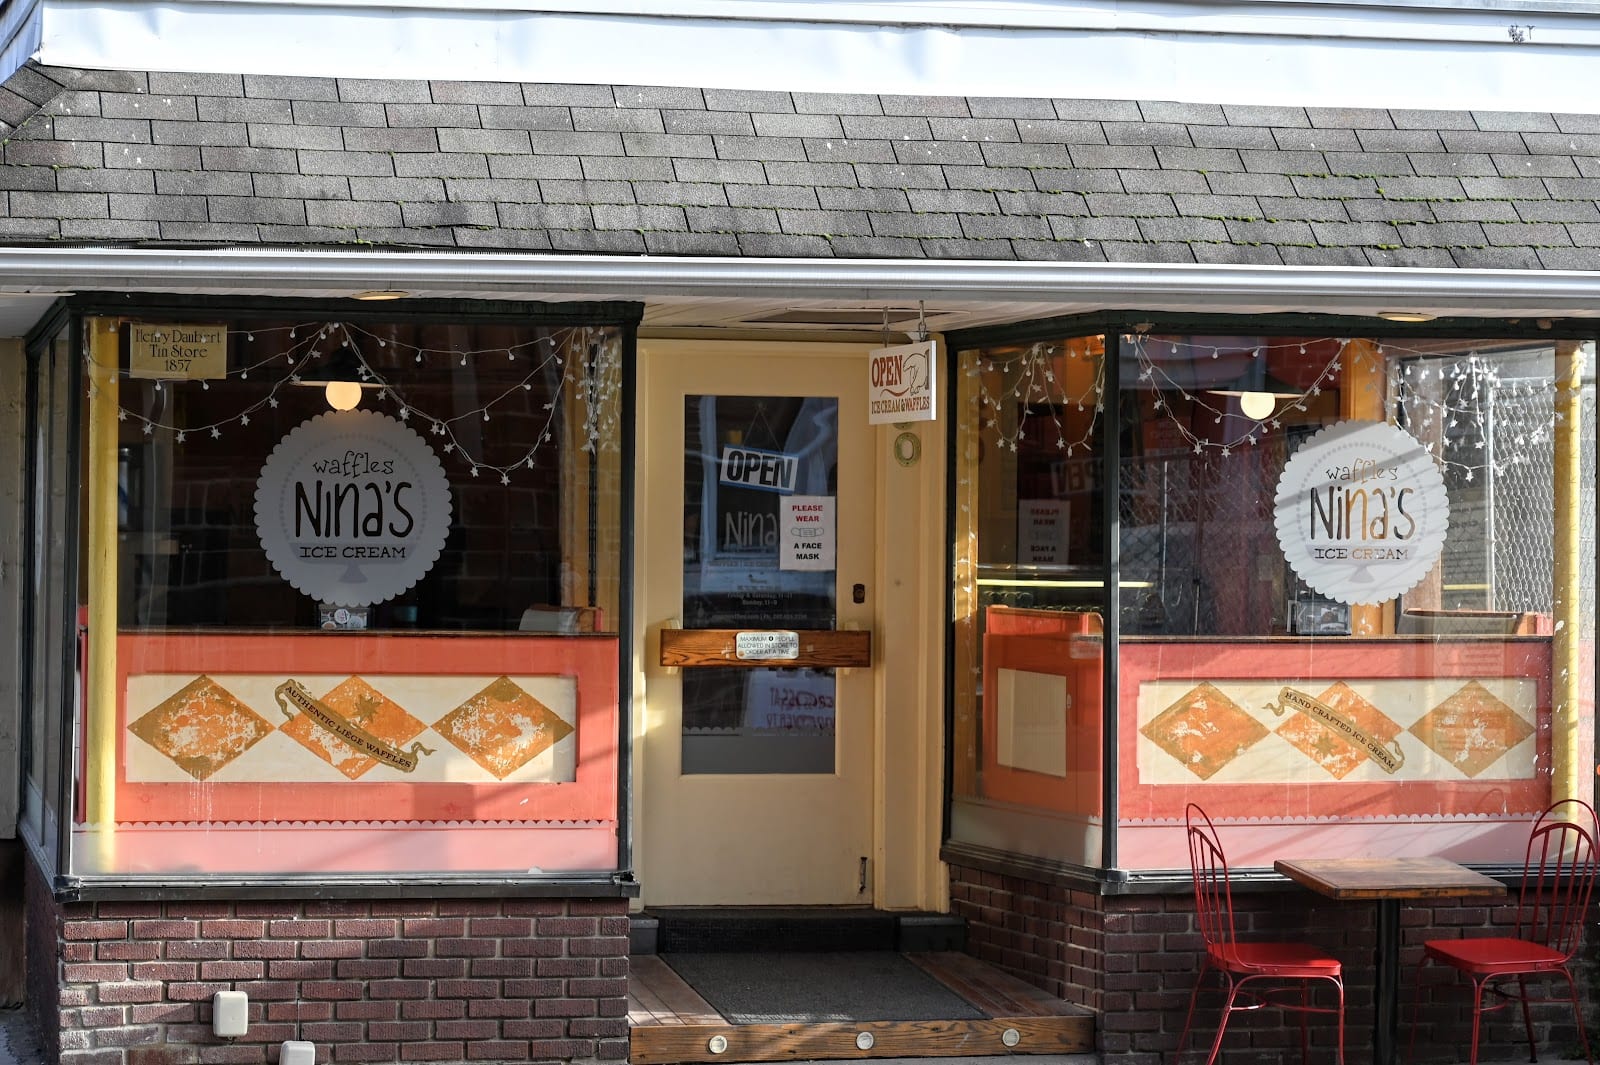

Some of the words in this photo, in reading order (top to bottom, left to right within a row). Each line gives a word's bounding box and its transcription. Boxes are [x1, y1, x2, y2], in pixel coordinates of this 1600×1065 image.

[135, 328, 170, 345] Henry
[149, 343, 168, 358] Tin
[170, 344, 208, 358] Store
[165, 359, 192, 372] 1857
[872, 354, 903, 388] OPEN
[871, 400, 880, 415] ICE
[881, 399, 901, 414] CREAM
[905, 396, 930, 412] WAFFLES
[312, 450, 394, 479] waffles
[726, 450, 793, 489] OPEN
[1326, 458, 1398, 485] waffles
[295, 480, 414, 538] Nina's
[792, 504, 824, 512] PLEASE
[796, 515, 820, 523] WEAR
[1310, 486, 1416, 541] Nina's
[300, 546, 338, 558] ICE
[342, 546, 407, 558] CREAM
[1314, 548, 1348, 560] ICE
[1352, 548, 1409, 560] CREAM
[285, 686, 336, 728] AUTHENTIC
[366, 741, 412, 768] WAFFLES
[1284, 692, 1311, 709] HAND
[1312, 706, 1353, 734] CRAFTED
[1352, 731, 1367, 745] ICE
[1368, 742, 1395, 769] CREAM
